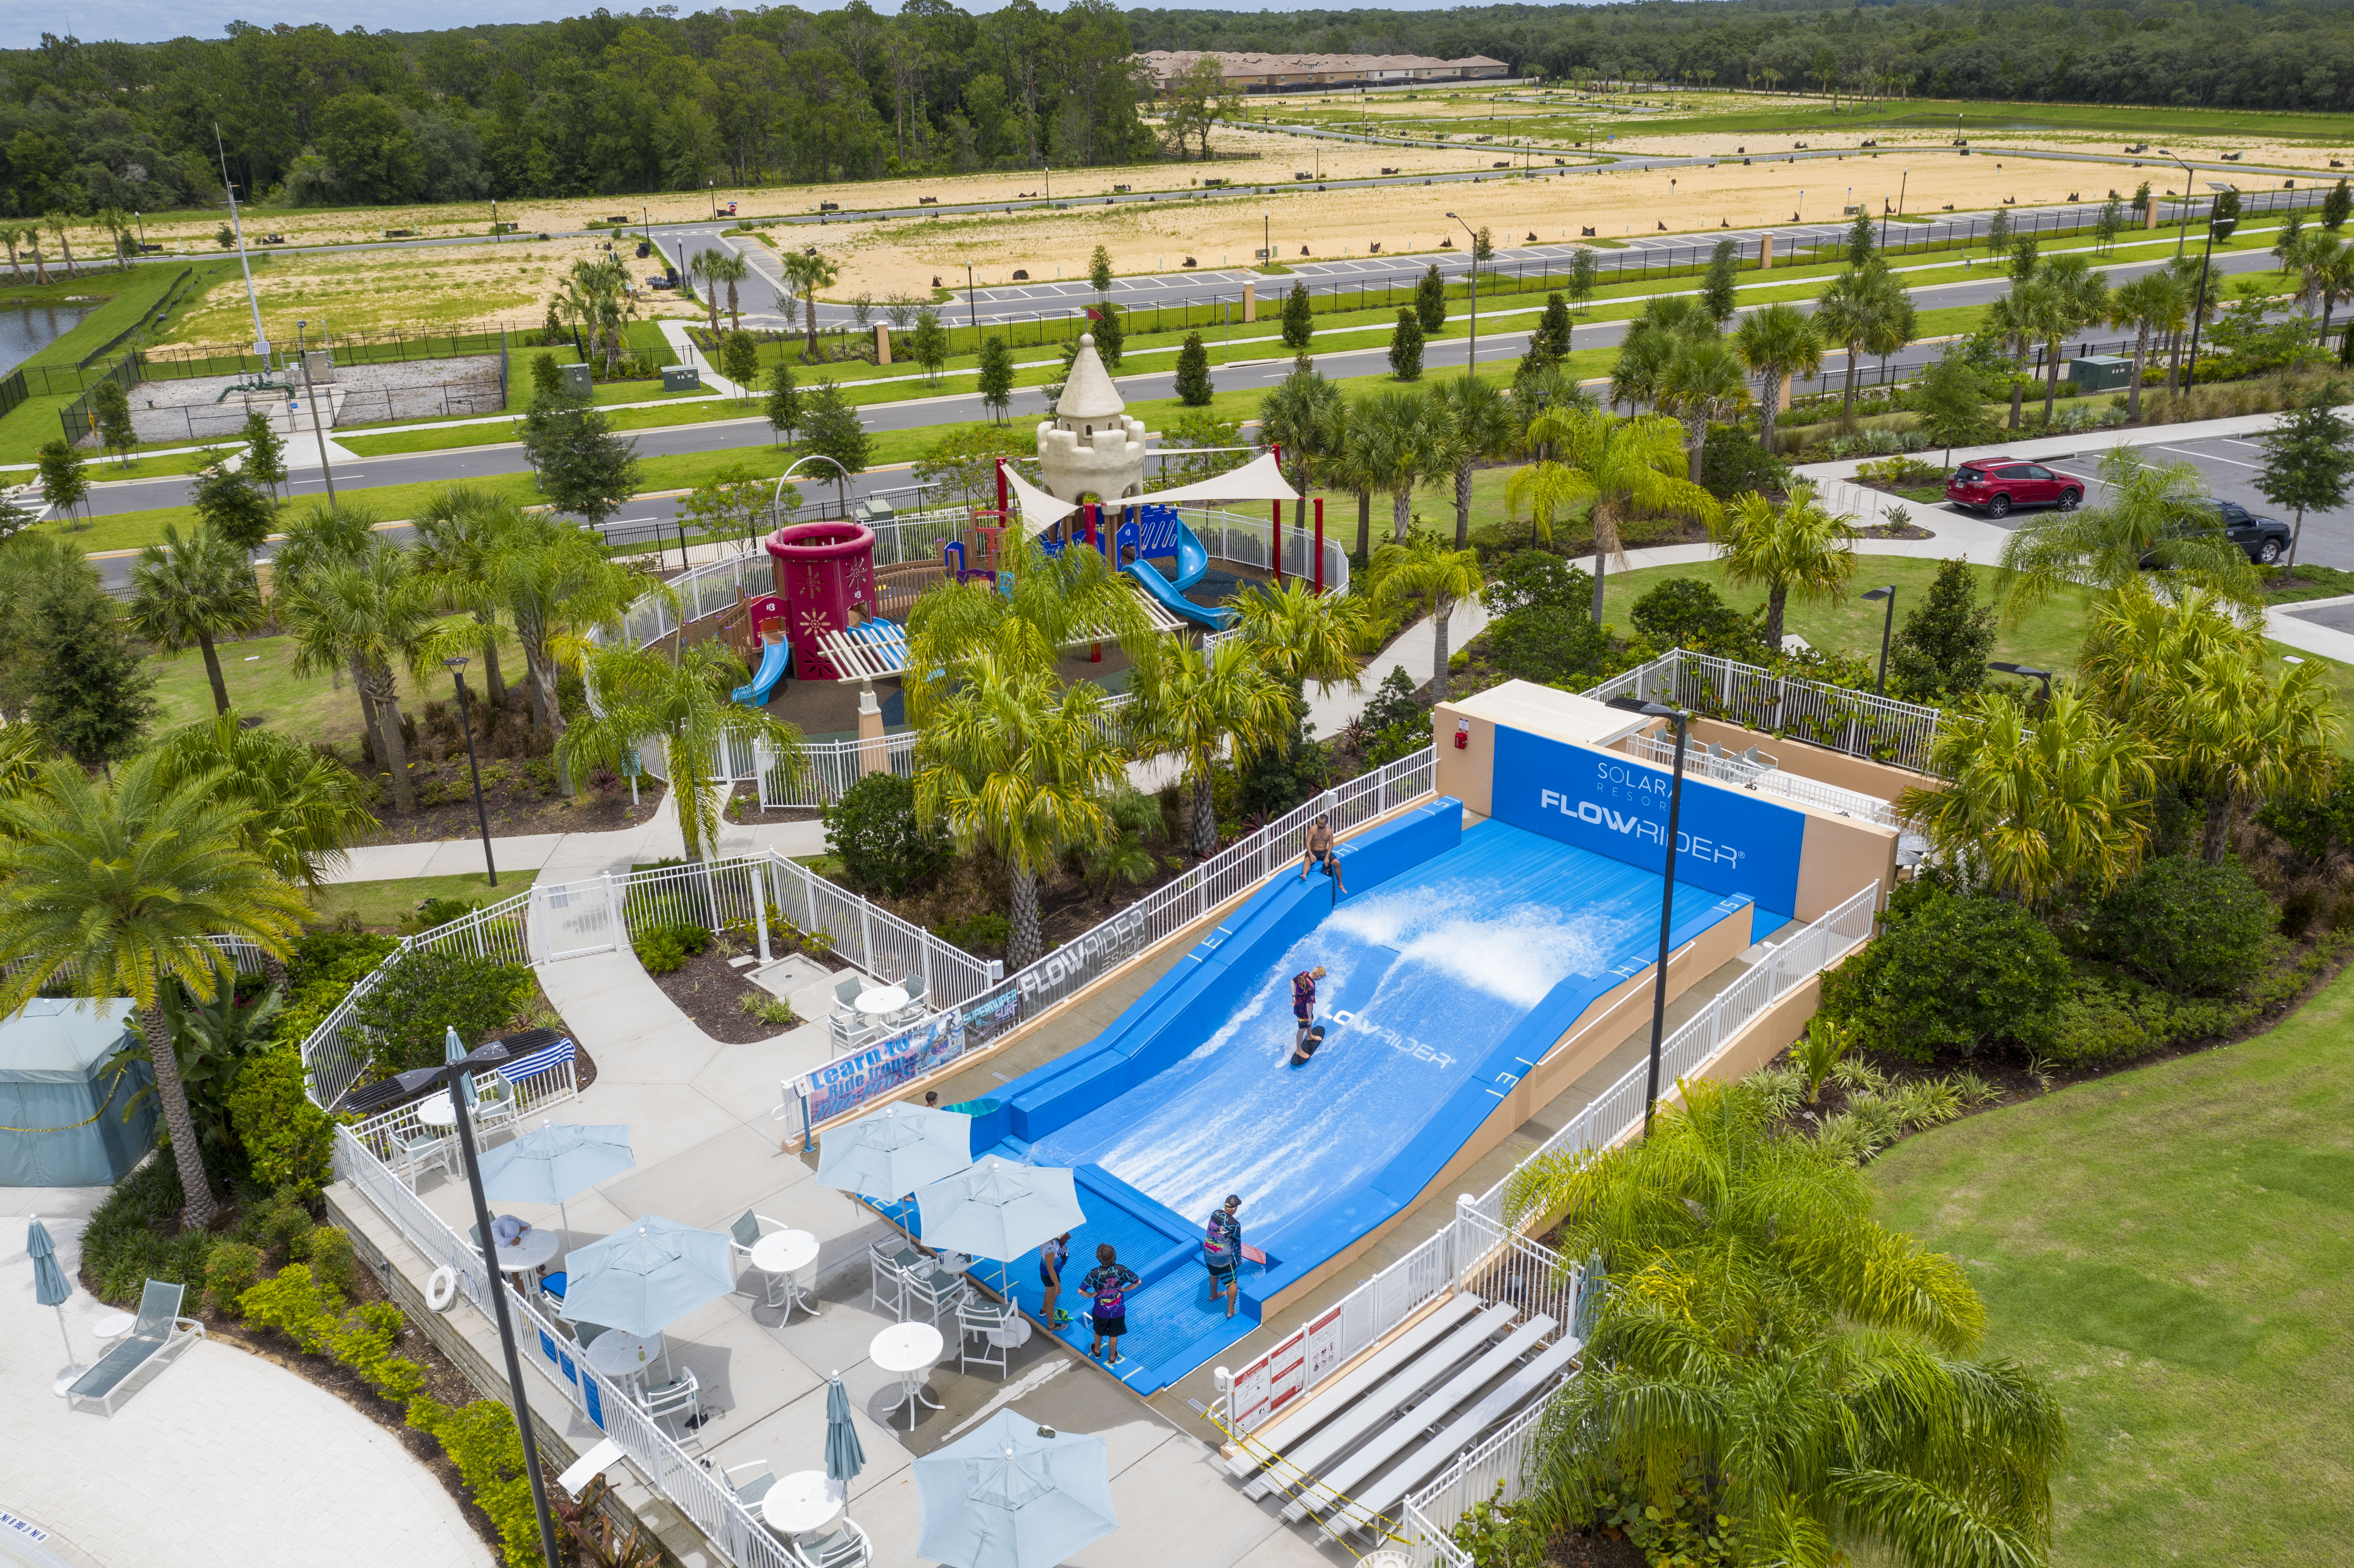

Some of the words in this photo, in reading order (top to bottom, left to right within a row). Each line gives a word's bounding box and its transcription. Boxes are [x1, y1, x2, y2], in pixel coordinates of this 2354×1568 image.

[1597, 762, 1681, 802] SOLAR
[1597, 782, 1681, 812] RESOR
[994, 999, 1018, 1021] SURF
[810, 1048, 882, 1091] Learn
[884, 1037, 910, 1056] to
[828, 1073, 865, 1101] Ride
[868, 1056, 906, 1082] from
[814, 1093, 859, 1121] The
[861, 1065, 916, 1101] Pro's
